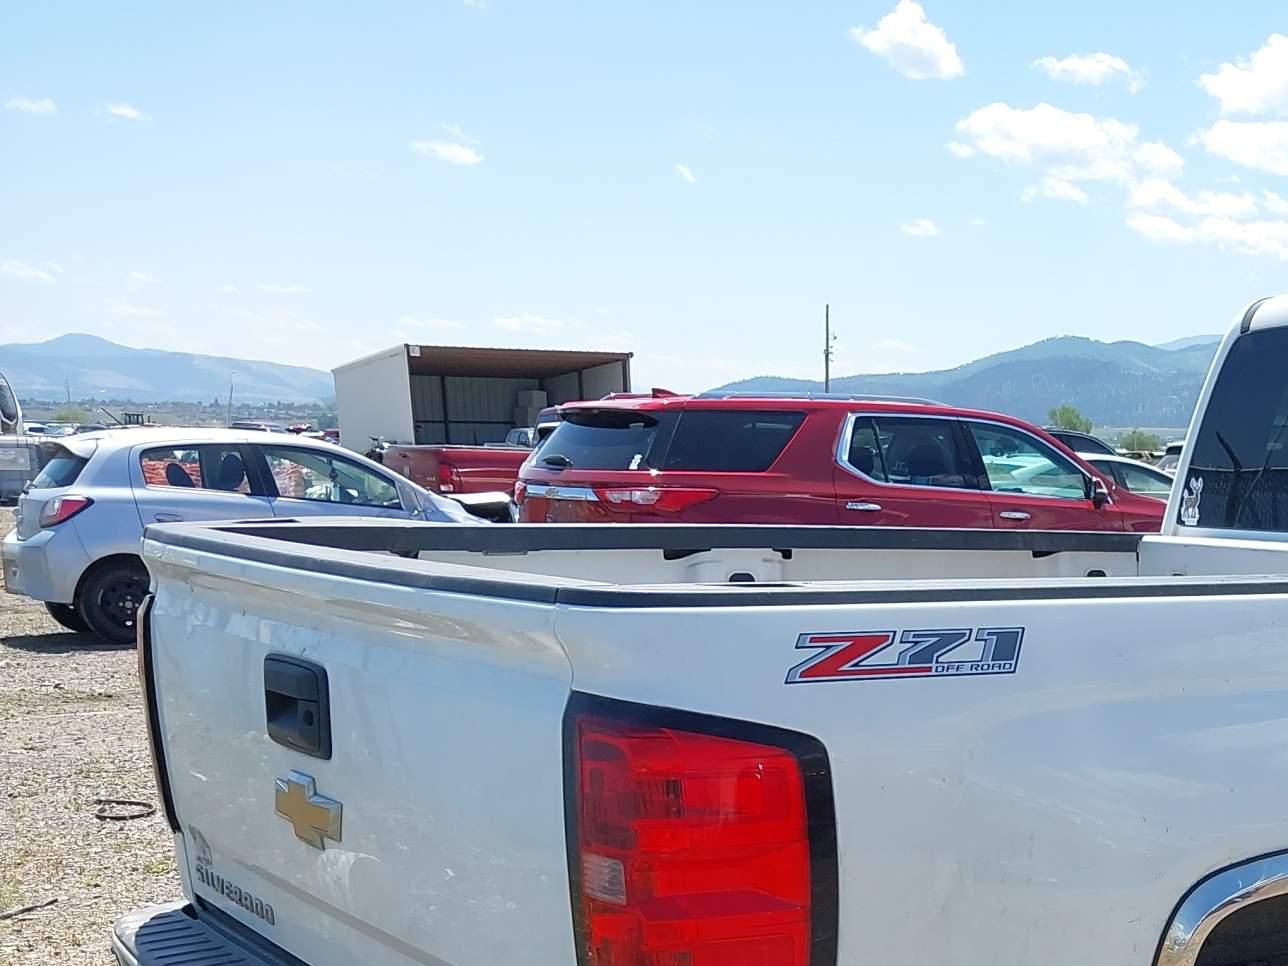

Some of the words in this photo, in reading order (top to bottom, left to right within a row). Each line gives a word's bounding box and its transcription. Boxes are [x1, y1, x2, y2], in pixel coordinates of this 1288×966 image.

[785, 627, 1025, 684] Z71
[934, 664, 966, 674] OFF
[970, 661, 1013, 673] ROAD
[195, 863, 276, 926] SILVERADO
